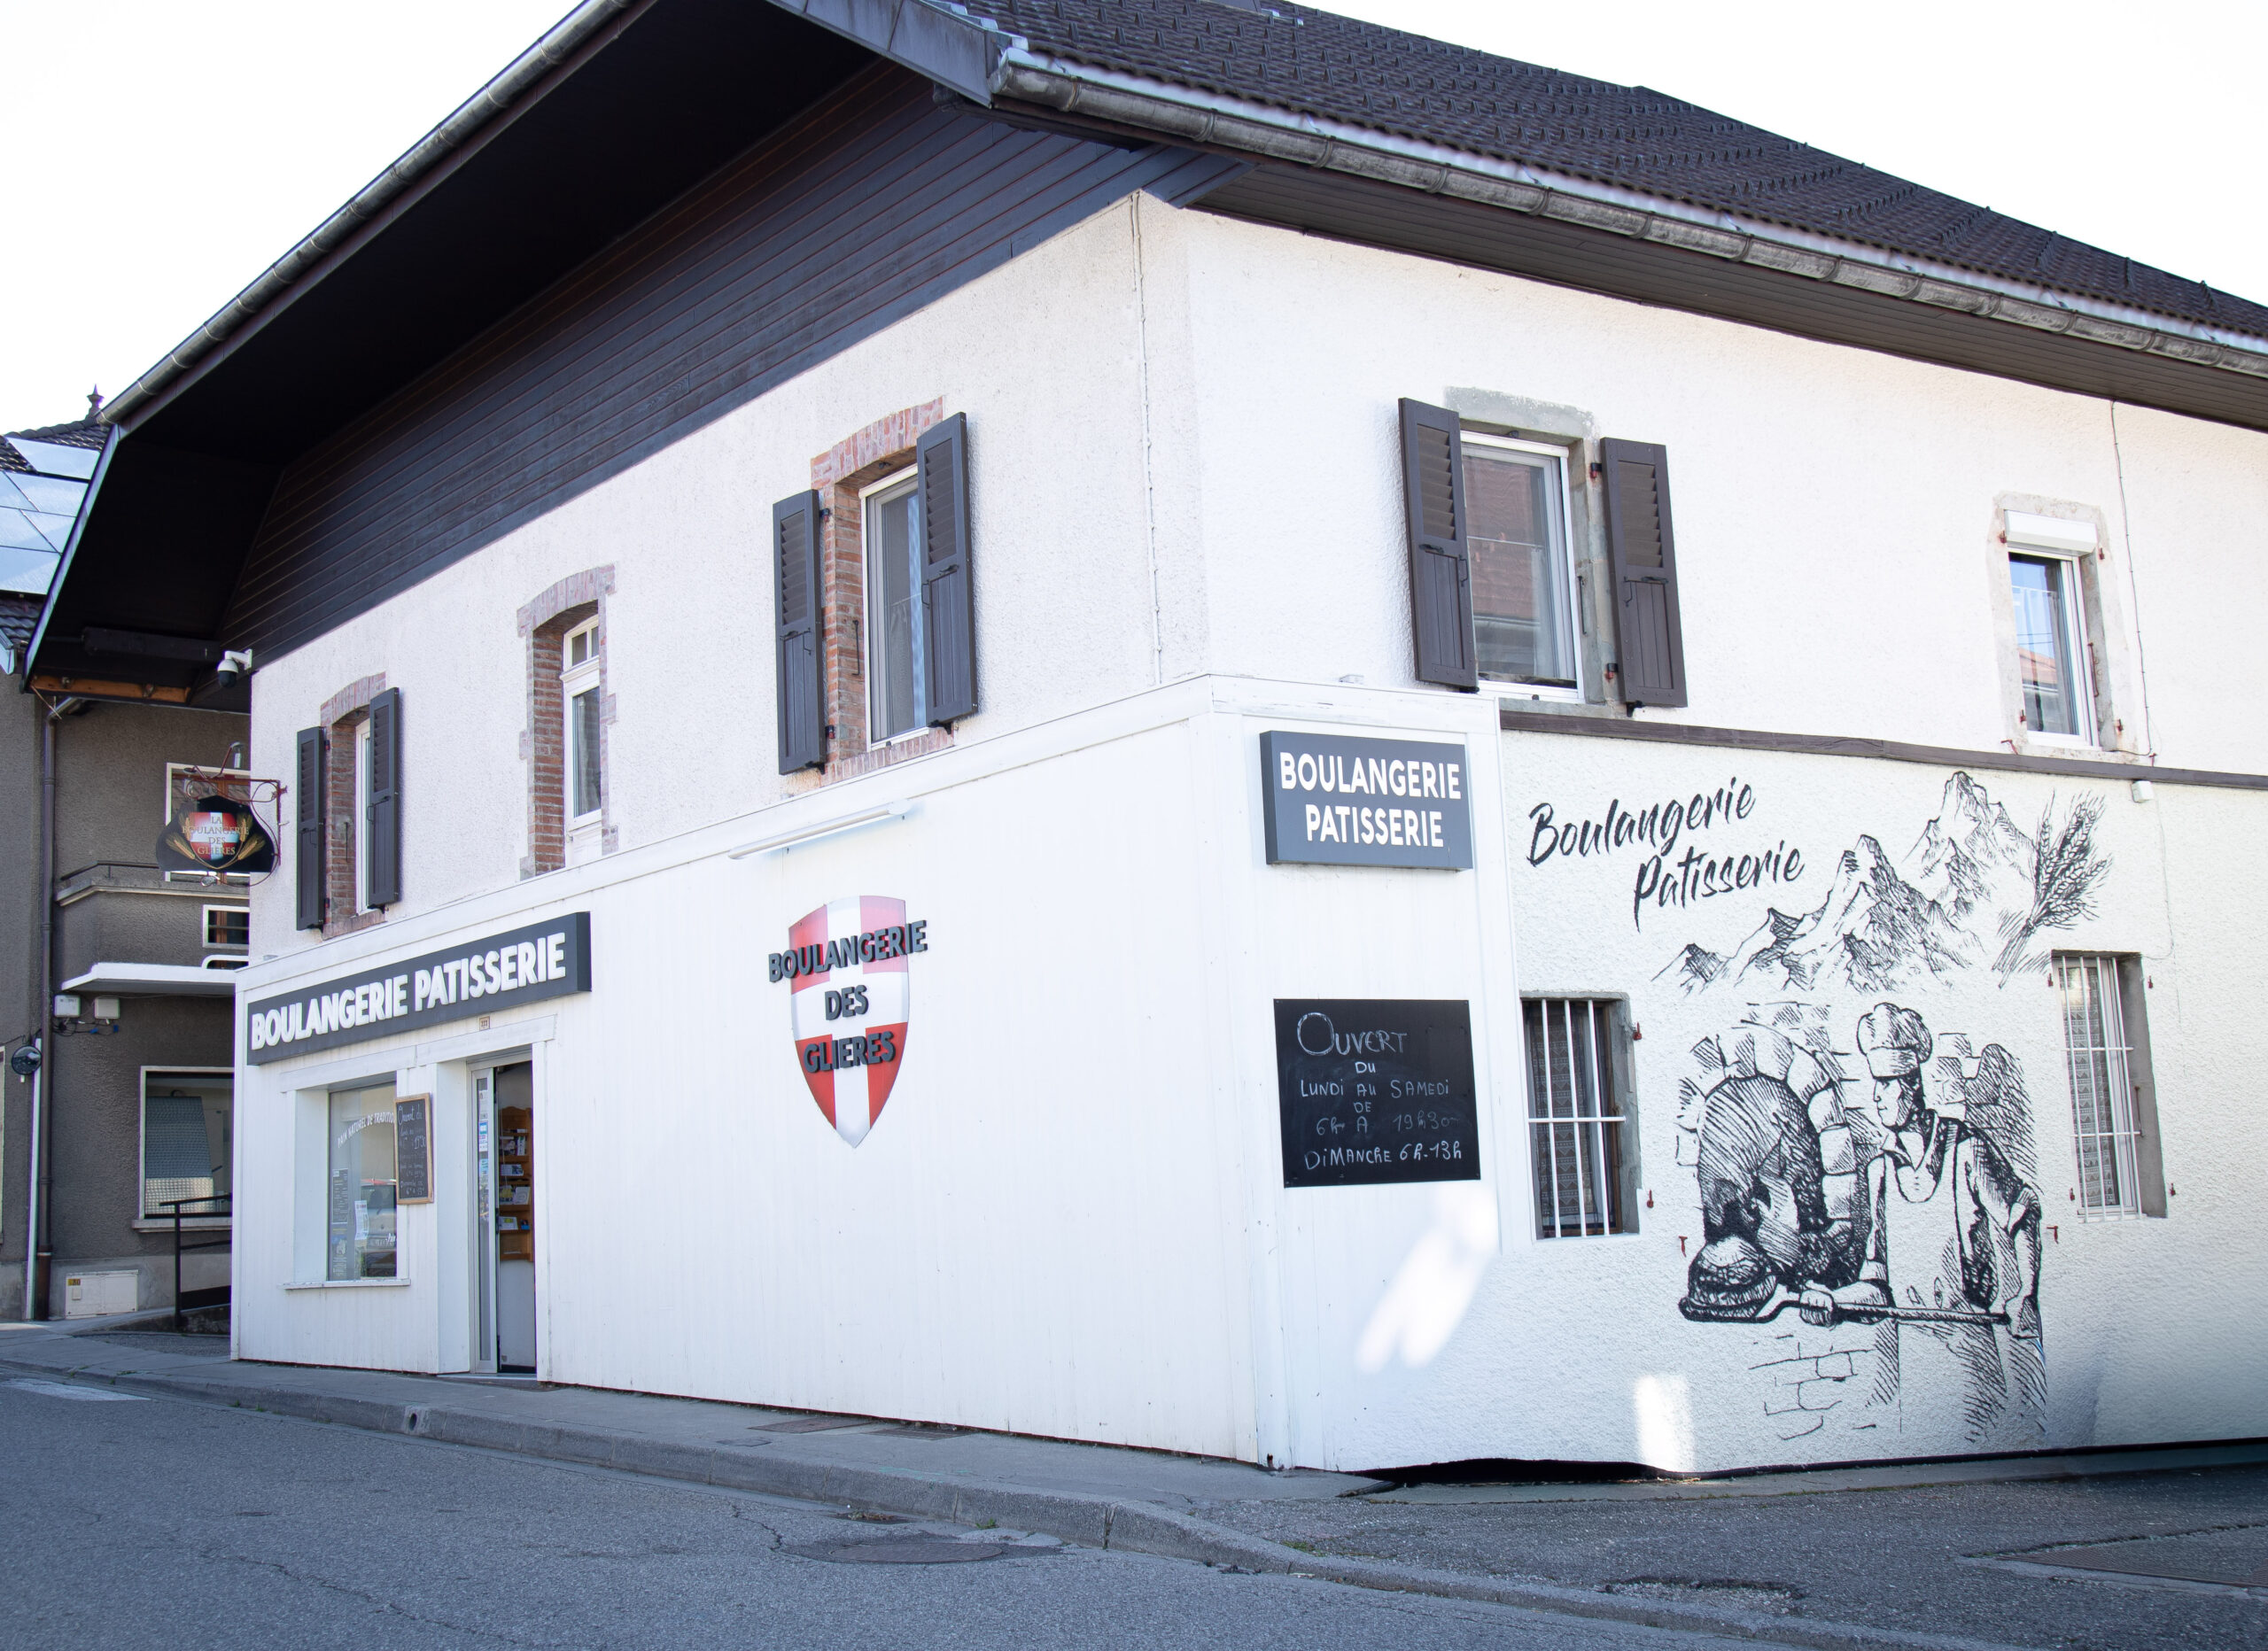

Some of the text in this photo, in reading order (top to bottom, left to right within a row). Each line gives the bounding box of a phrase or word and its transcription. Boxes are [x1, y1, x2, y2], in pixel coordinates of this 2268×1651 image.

[1280, 752, 1462, 800] BOULANGERIE
[183, 826, 250, 835] BOULANGERIE
[211, 816, 222, 825] LA
[1305, 803, 1444, 848] PATISSERIE
[1526, 777, 1756, 867] Boulangerie
[1634, 840, 1805, 933] Patisserie
[768, 919, 928, 982] BOULANGERIE
[251, 932, 567, 1050] BOULANGERIE PATISSERIE
[825, 985, 869, 1021] DES
[804, 1030, 897, 1074] GLIERES
[374, 1112, 395, 1124] TRADITIO
[1354, 1102, 1371, 1112] DE
